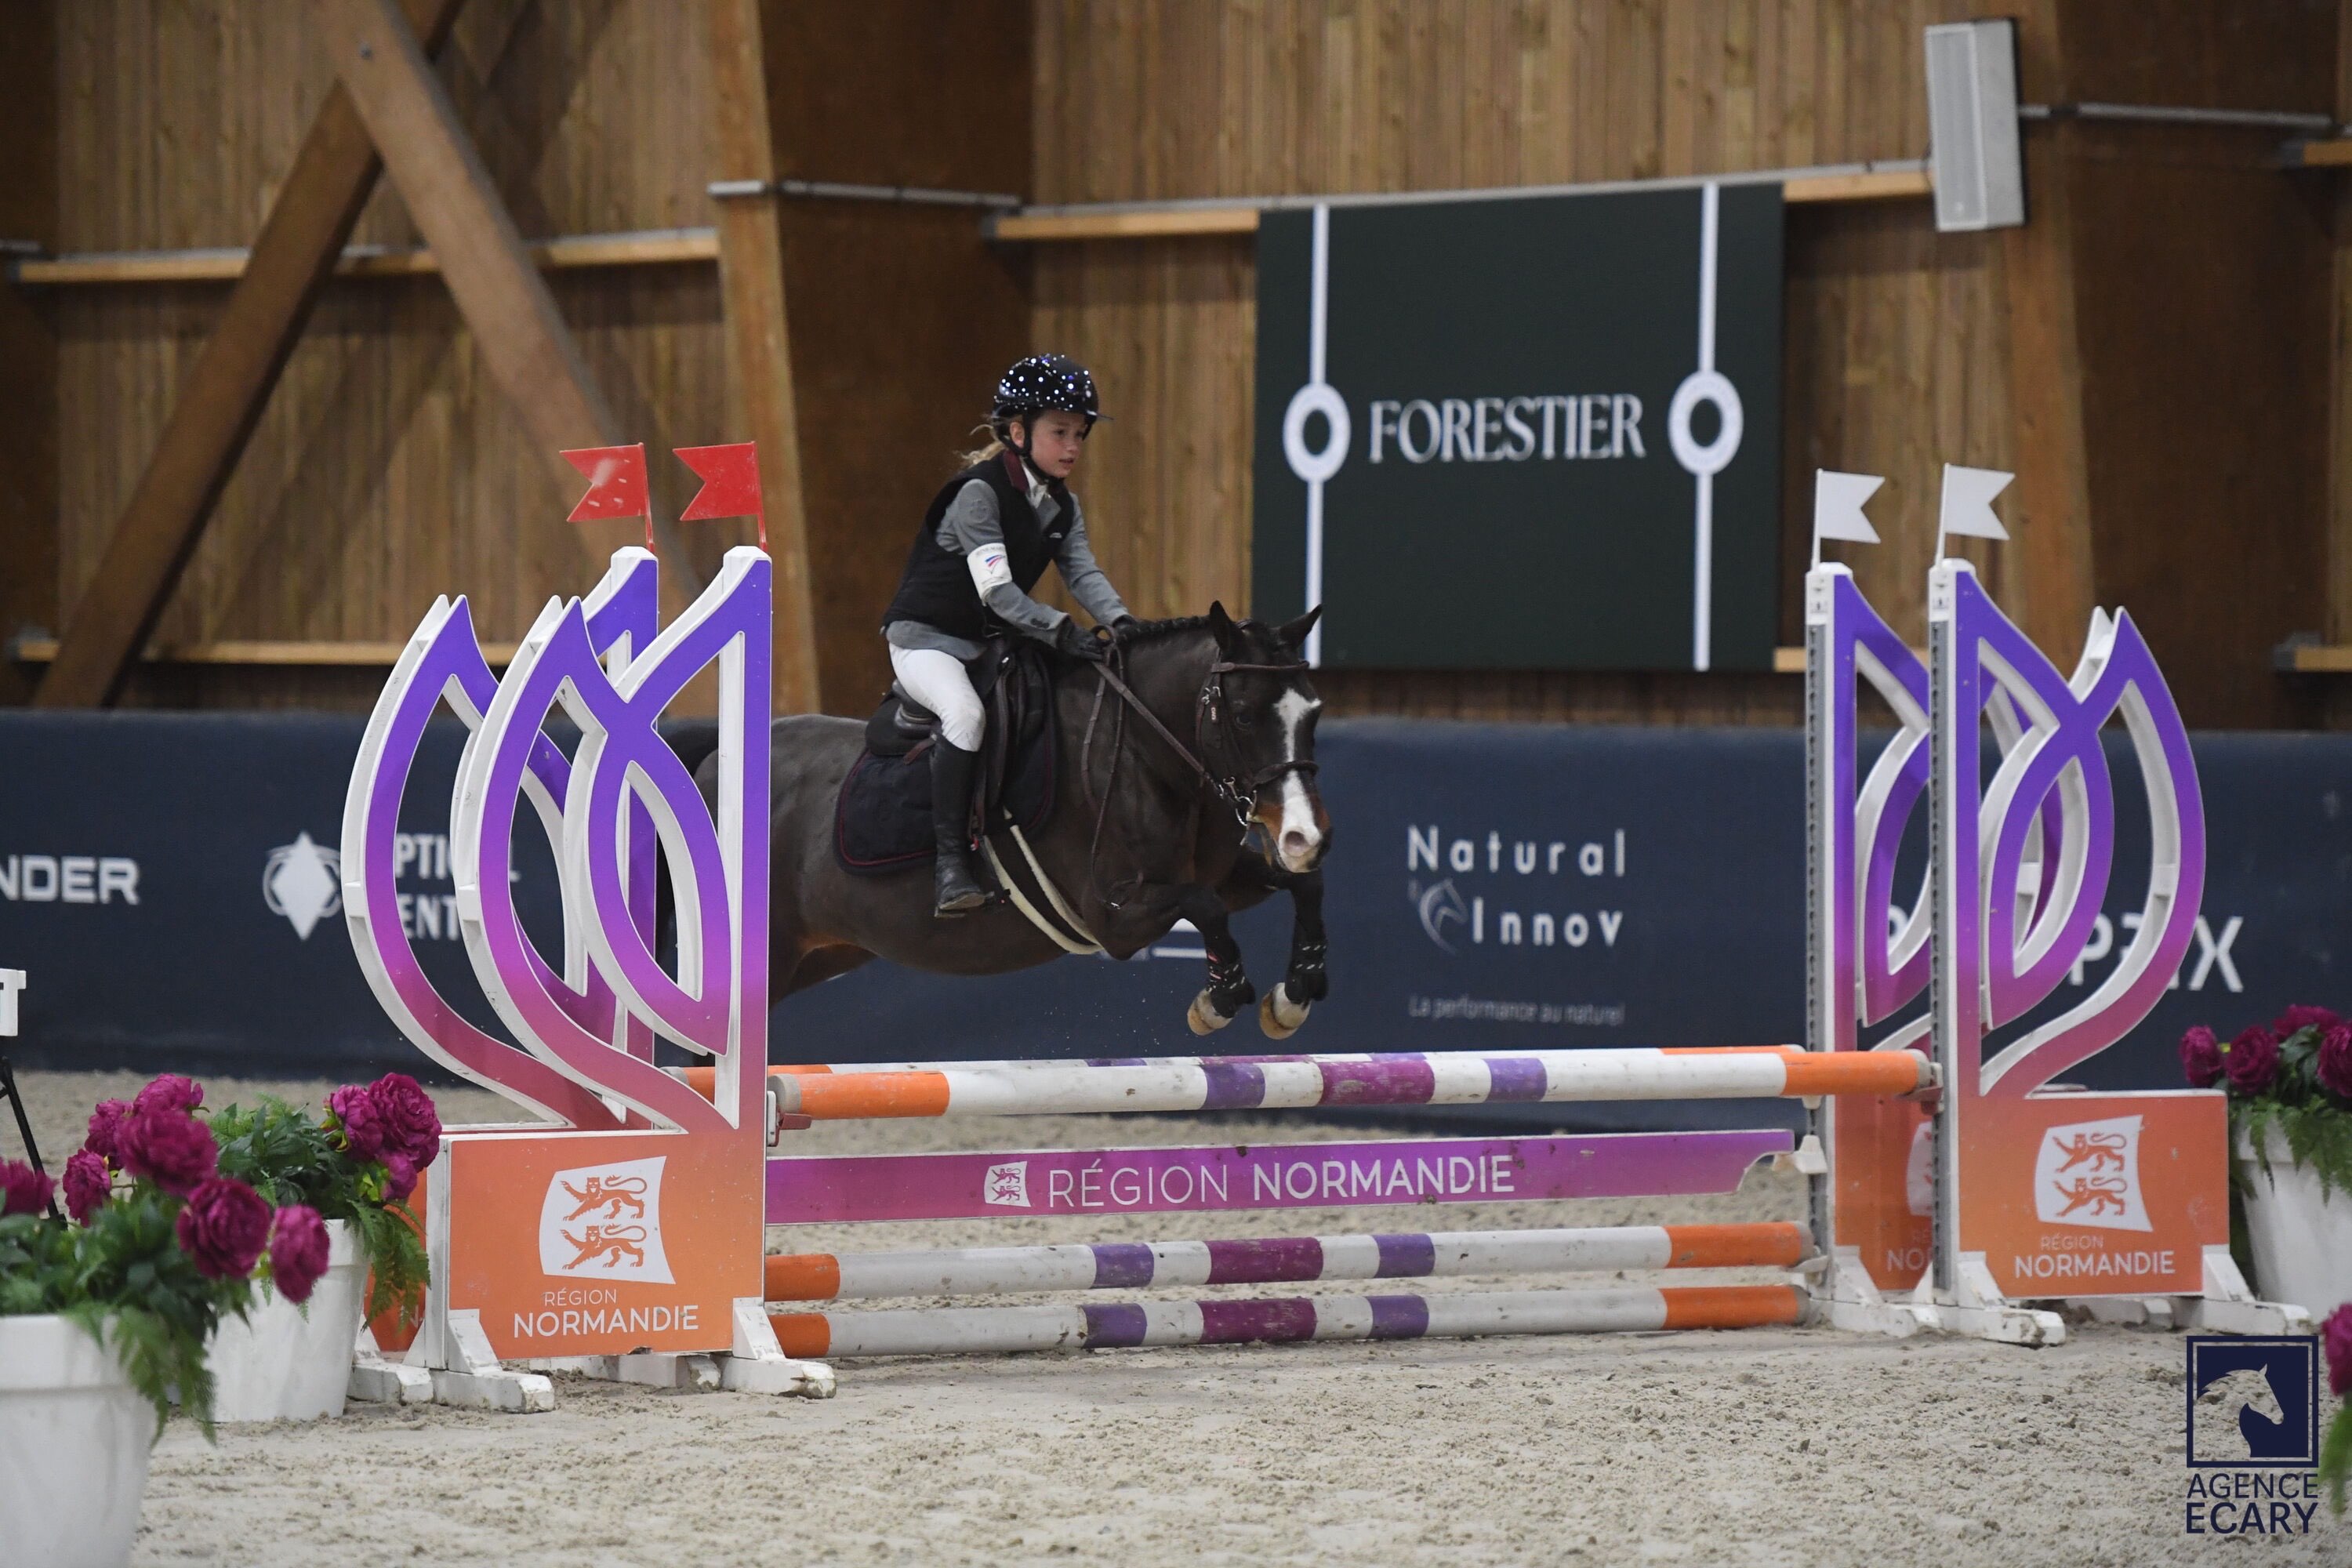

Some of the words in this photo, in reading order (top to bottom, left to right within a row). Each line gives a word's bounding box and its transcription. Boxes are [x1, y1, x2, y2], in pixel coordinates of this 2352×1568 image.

[1369, 394, 1647, 464] FORESTIER
[1407, 825, 1626, 877] Natural
[1472, 896, 1623, 947] Innov
[1048, 1159, 1229, 1208] RÉGION
[1253, 1154, 1515, 1201] NORMANDIE
[2040, 1233, 2104, 1250] RÉGION
[2014, 1250, 2176, 1279] NORMANDIE
[544, 1287, 617, 1307] RÉGION
[514, 1305, 699, 1338] NORMANDIE
